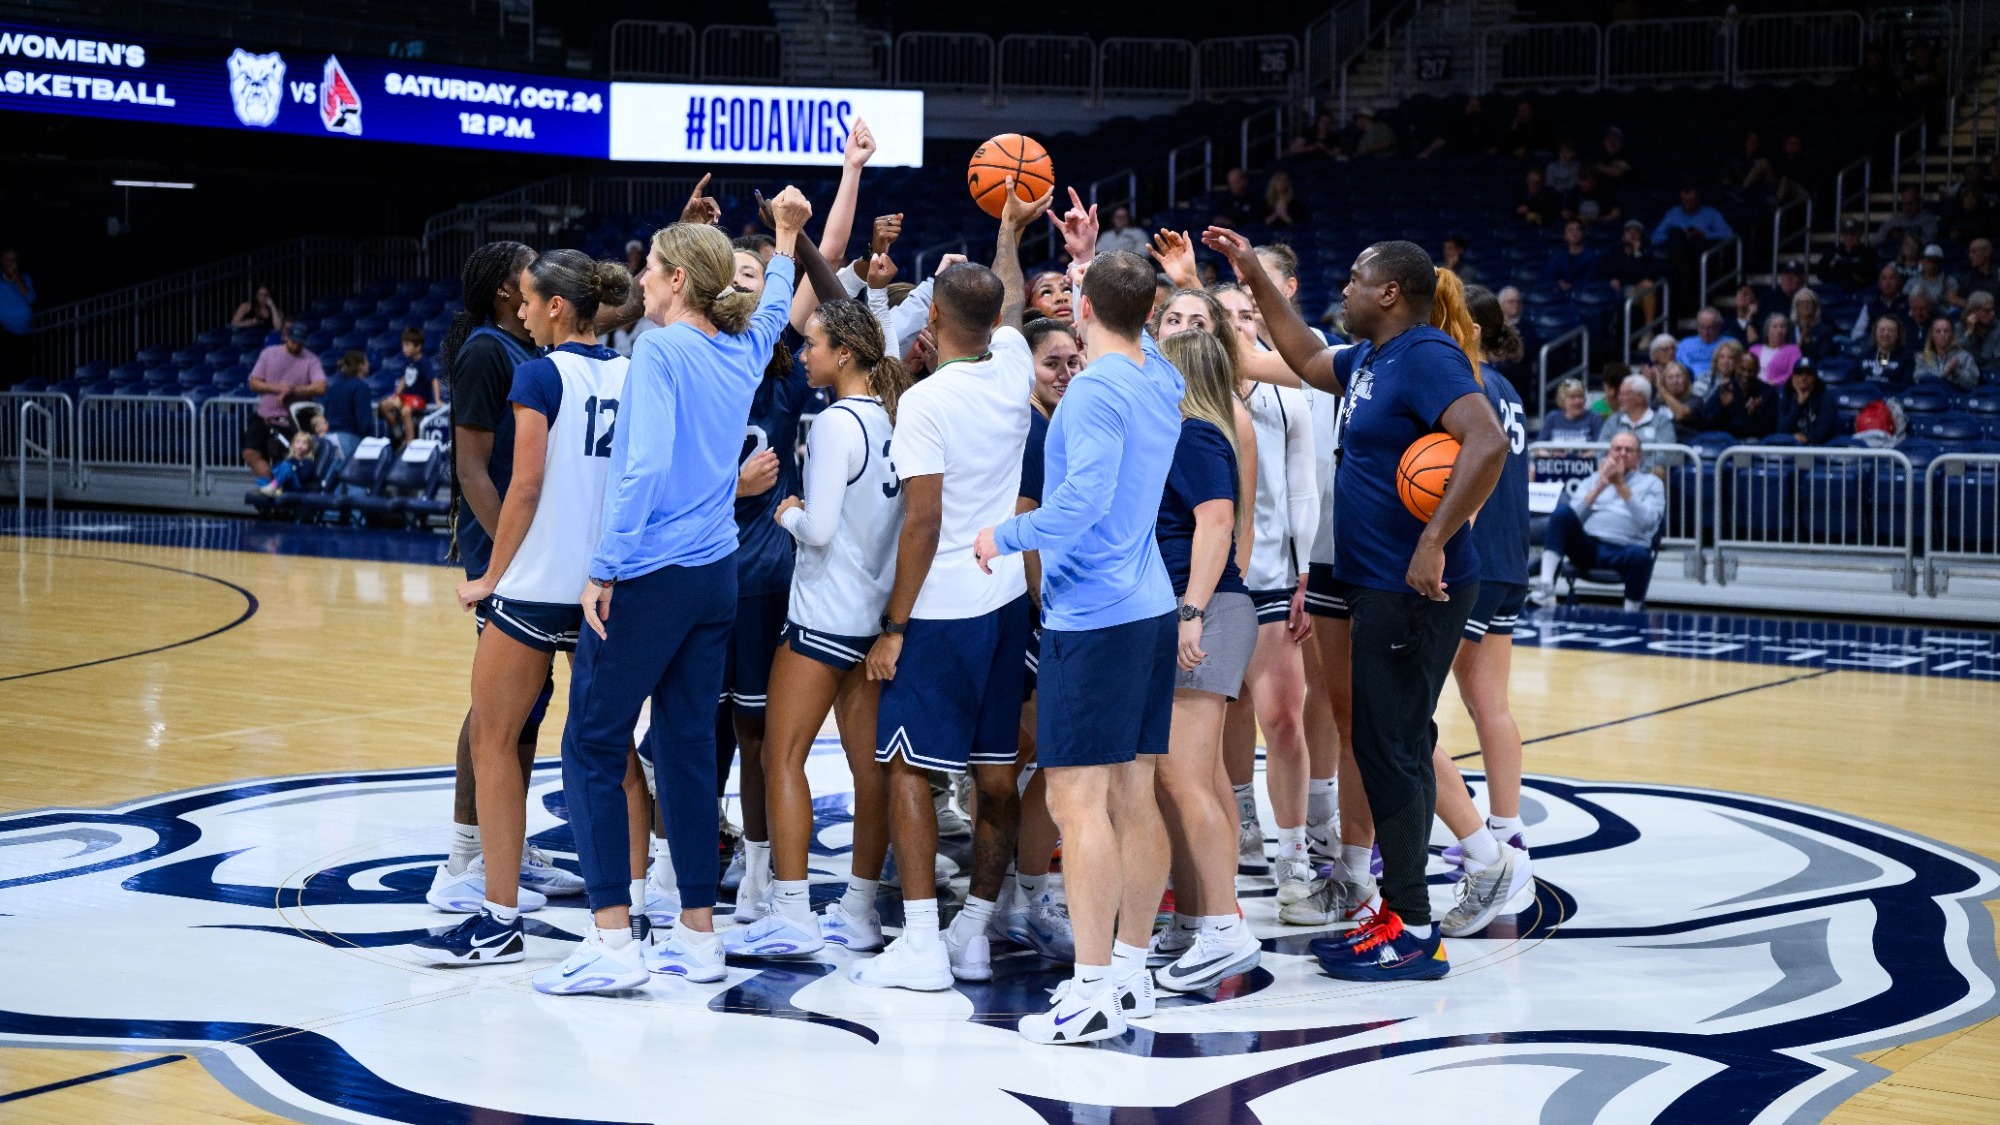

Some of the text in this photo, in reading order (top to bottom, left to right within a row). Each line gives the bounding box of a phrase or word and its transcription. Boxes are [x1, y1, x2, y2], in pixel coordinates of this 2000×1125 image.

[0, 32, 146, 68] WOMEN'S
[0, 70, 176, 107] SKETBALL
[290, 81, 317, 104] VS
[458, 112, 536, 139] 12 P.M.
[685, 96, 851, 154] #GODAWGS
[584, 394, 620, 458] 12
[1500, 398, 1525, 455] 25
[1536, 459, 1595, 474] SECTION
